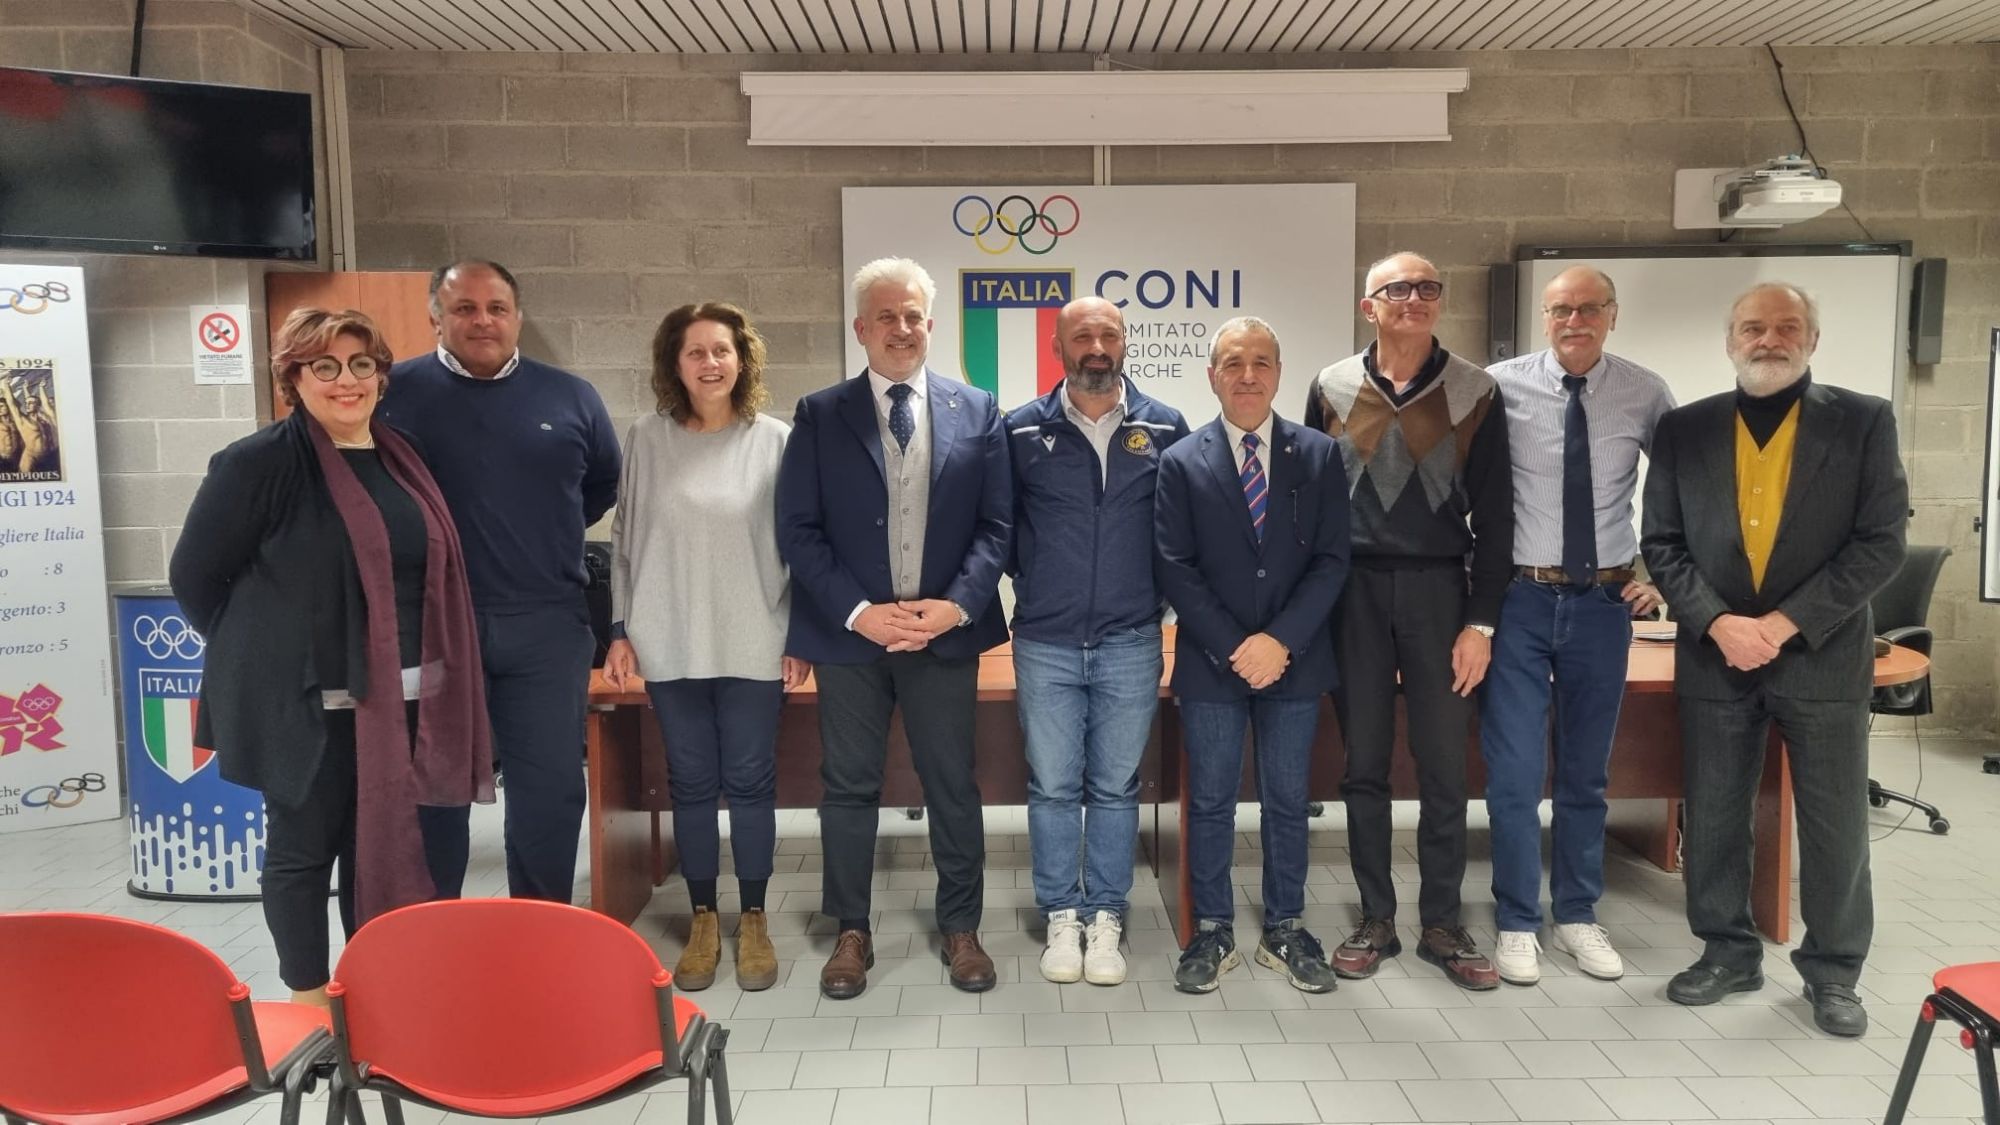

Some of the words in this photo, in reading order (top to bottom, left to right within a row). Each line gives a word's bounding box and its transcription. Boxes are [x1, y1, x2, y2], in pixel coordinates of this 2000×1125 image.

[972, 280, 1065, 301] ITALIA
[1095, 270, 1241, 309] CONI
[1124, 322, 1206, 338] MITATO
[1126, 343, 1211, 358] GIONAL
[16, 358, 53, 369] 1924
[1123, 363, 1182, 378] RCHE
[0, 471, 60, 481] LYMPIQUES
[34, 489, 76, 506] 1924
[44, 526, 85, 541] Italia
[53, 562, 63, 575] 8
[56, 601, 66, 614] 3
[59, 638, 68, 651] 5
